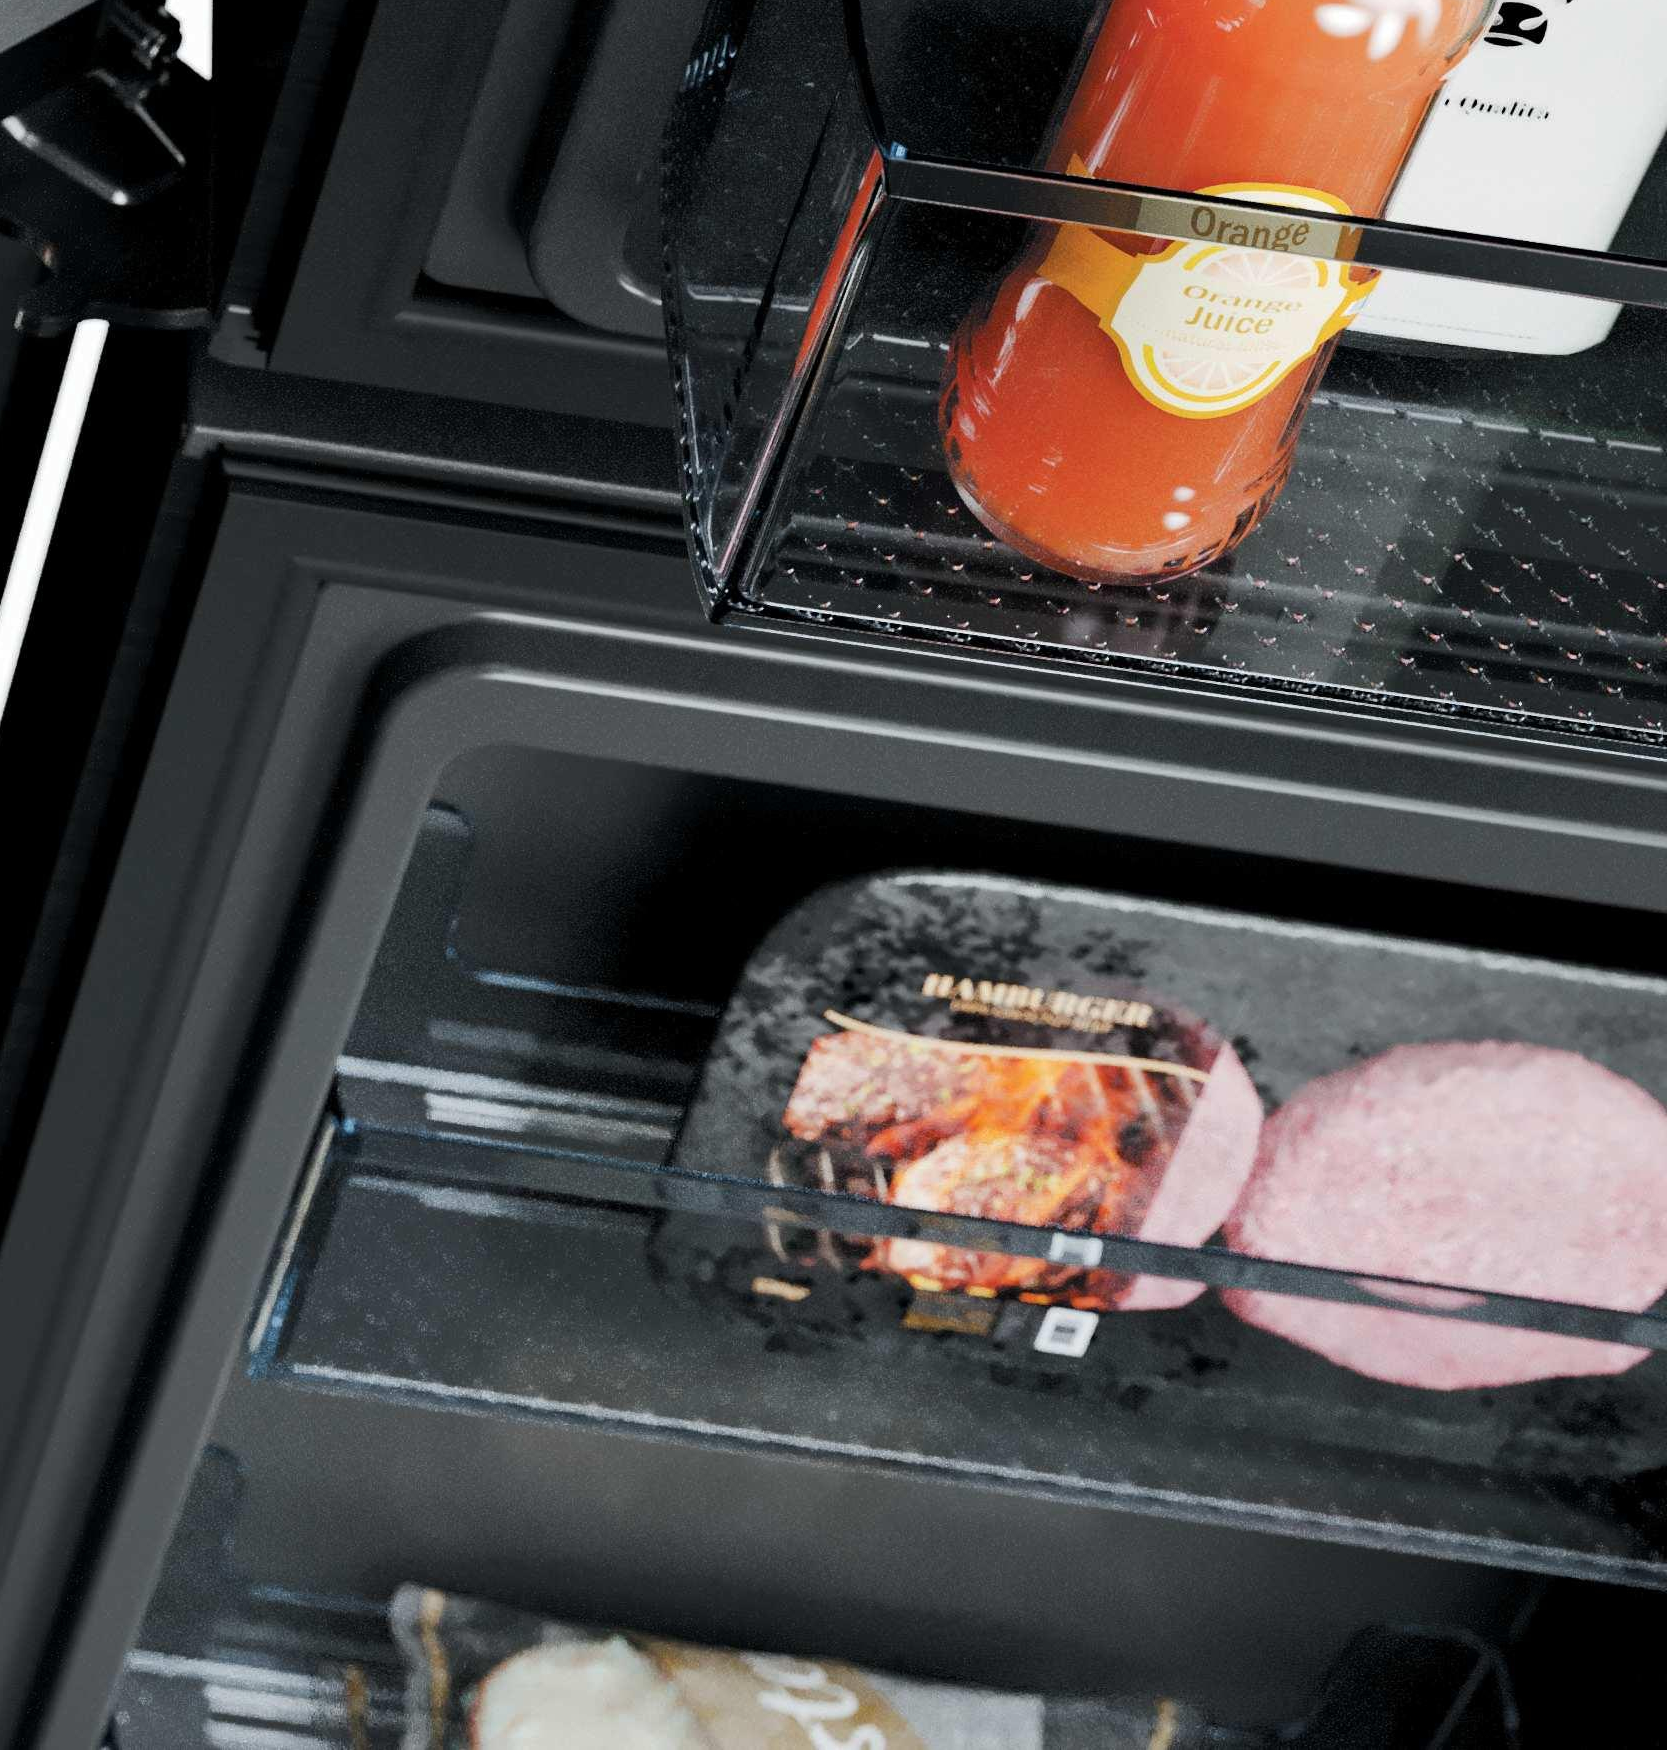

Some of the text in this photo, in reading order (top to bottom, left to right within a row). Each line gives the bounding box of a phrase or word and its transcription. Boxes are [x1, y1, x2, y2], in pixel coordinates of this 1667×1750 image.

[1191, 205, 1310, 251] Orange
[1182, 284, 1304, 313] Orange
[1184, 306, 1275, 334] Juice
[922, 972, 1154, 1029] HAMBURGER
